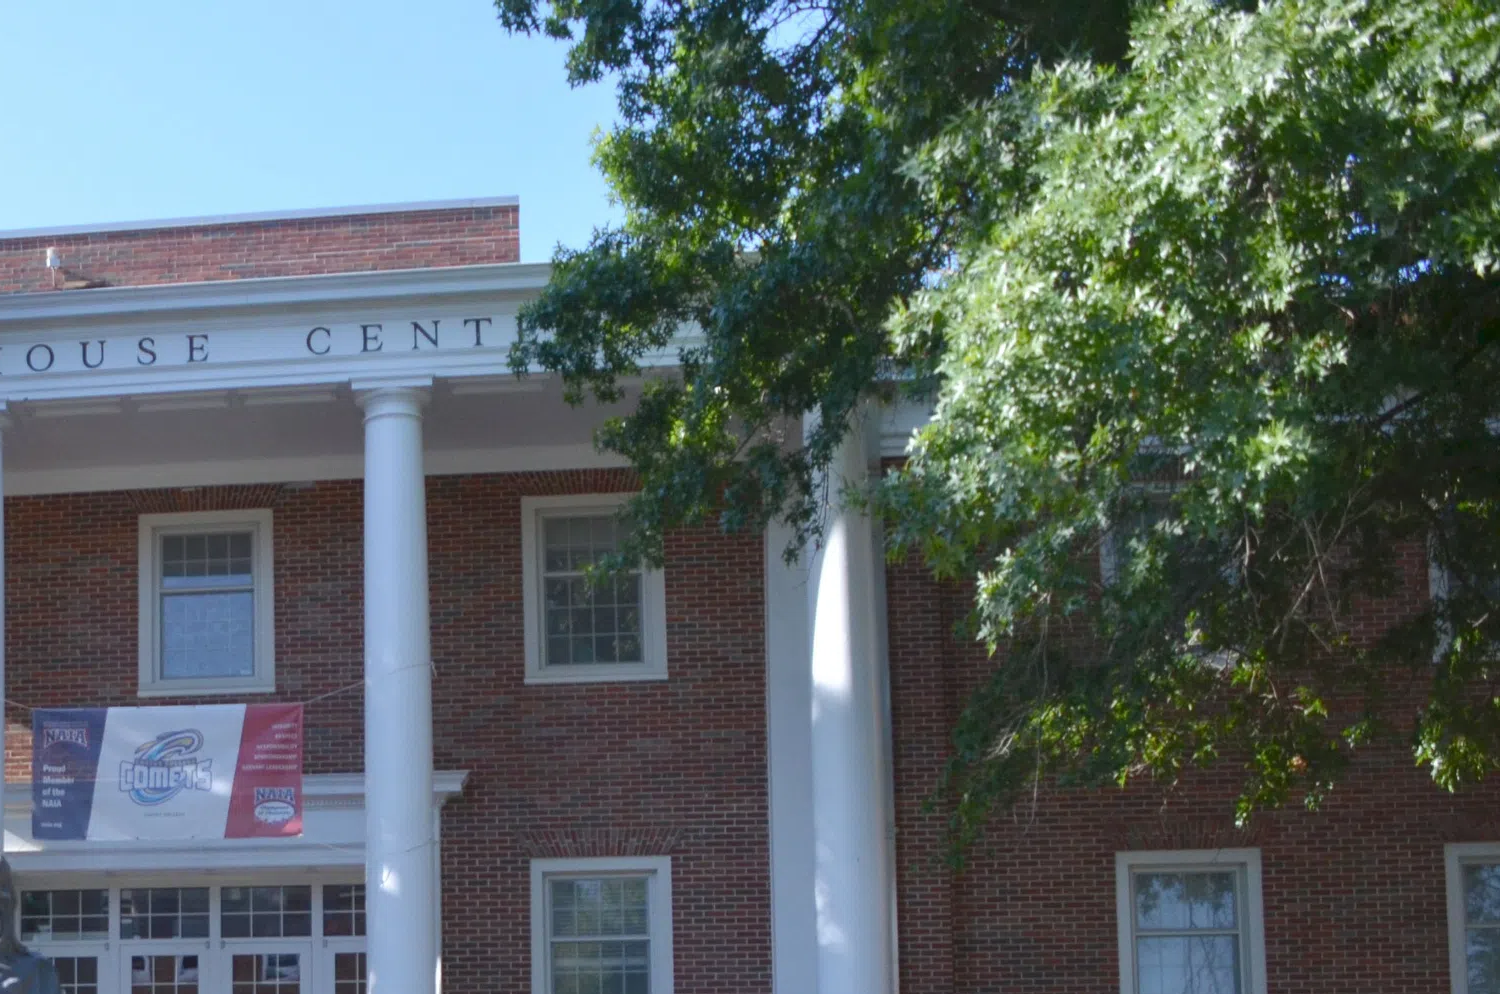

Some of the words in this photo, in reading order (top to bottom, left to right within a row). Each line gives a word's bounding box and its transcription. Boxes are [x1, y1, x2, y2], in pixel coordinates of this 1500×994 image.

[43, 729, 88, 749] NAIA
[43, 763, 66, 773] Proud
[42, 775, 75, 785] Member
[118, 759, 213, 793] COMETS
[42, 787, 51, 797] of
[52, 787, 66, 797] the
[256, 787, 294, 802] NAIA
[42, 799, 62, 808] NAIA
